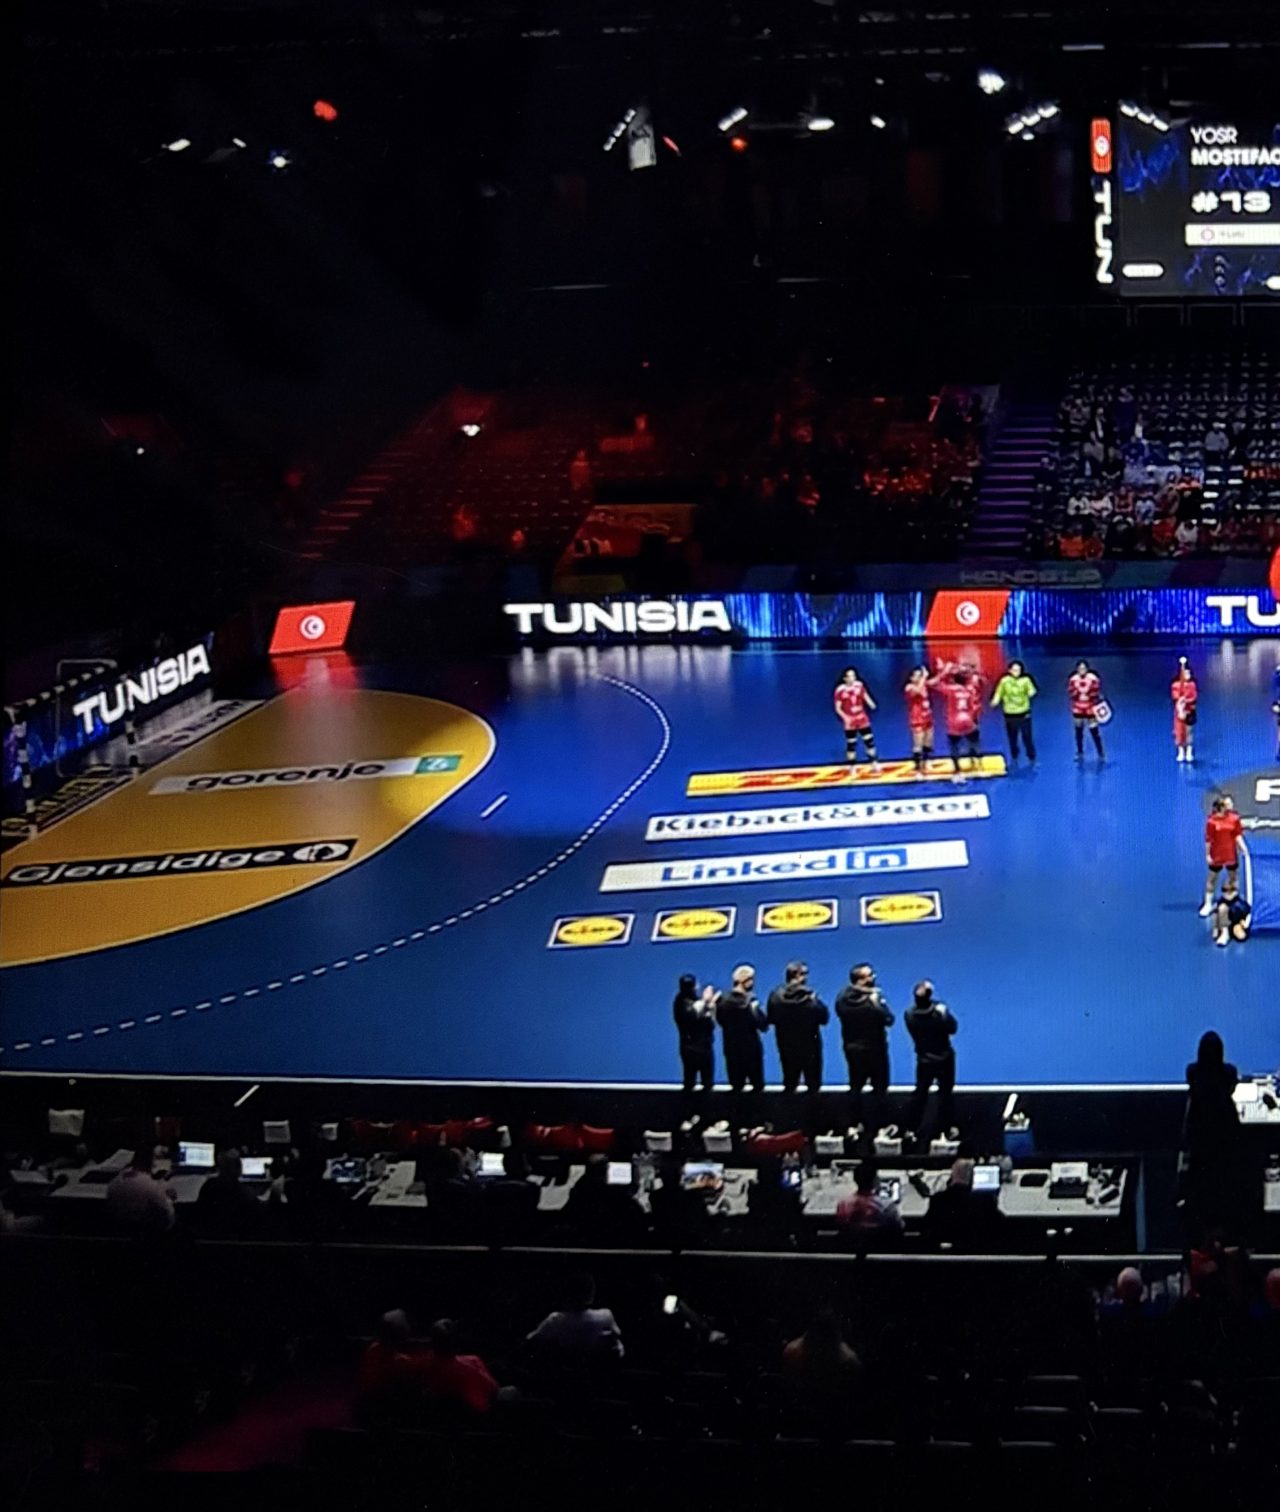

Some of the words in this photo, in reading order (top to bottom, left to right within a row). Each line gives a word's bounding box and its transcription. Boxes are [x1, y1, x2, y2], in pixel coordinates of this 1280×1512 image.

[1191, 125, 1238, 144] YOSR
[503, 602, 731, 632] TUNISIA
[72, 644, 211, 734] TUNISIA
[186, 762, 385, 792] gorenje
[655, 799, 979, 832] Kieback&Peter
[8, 847, 286, 884] Gjensidige
